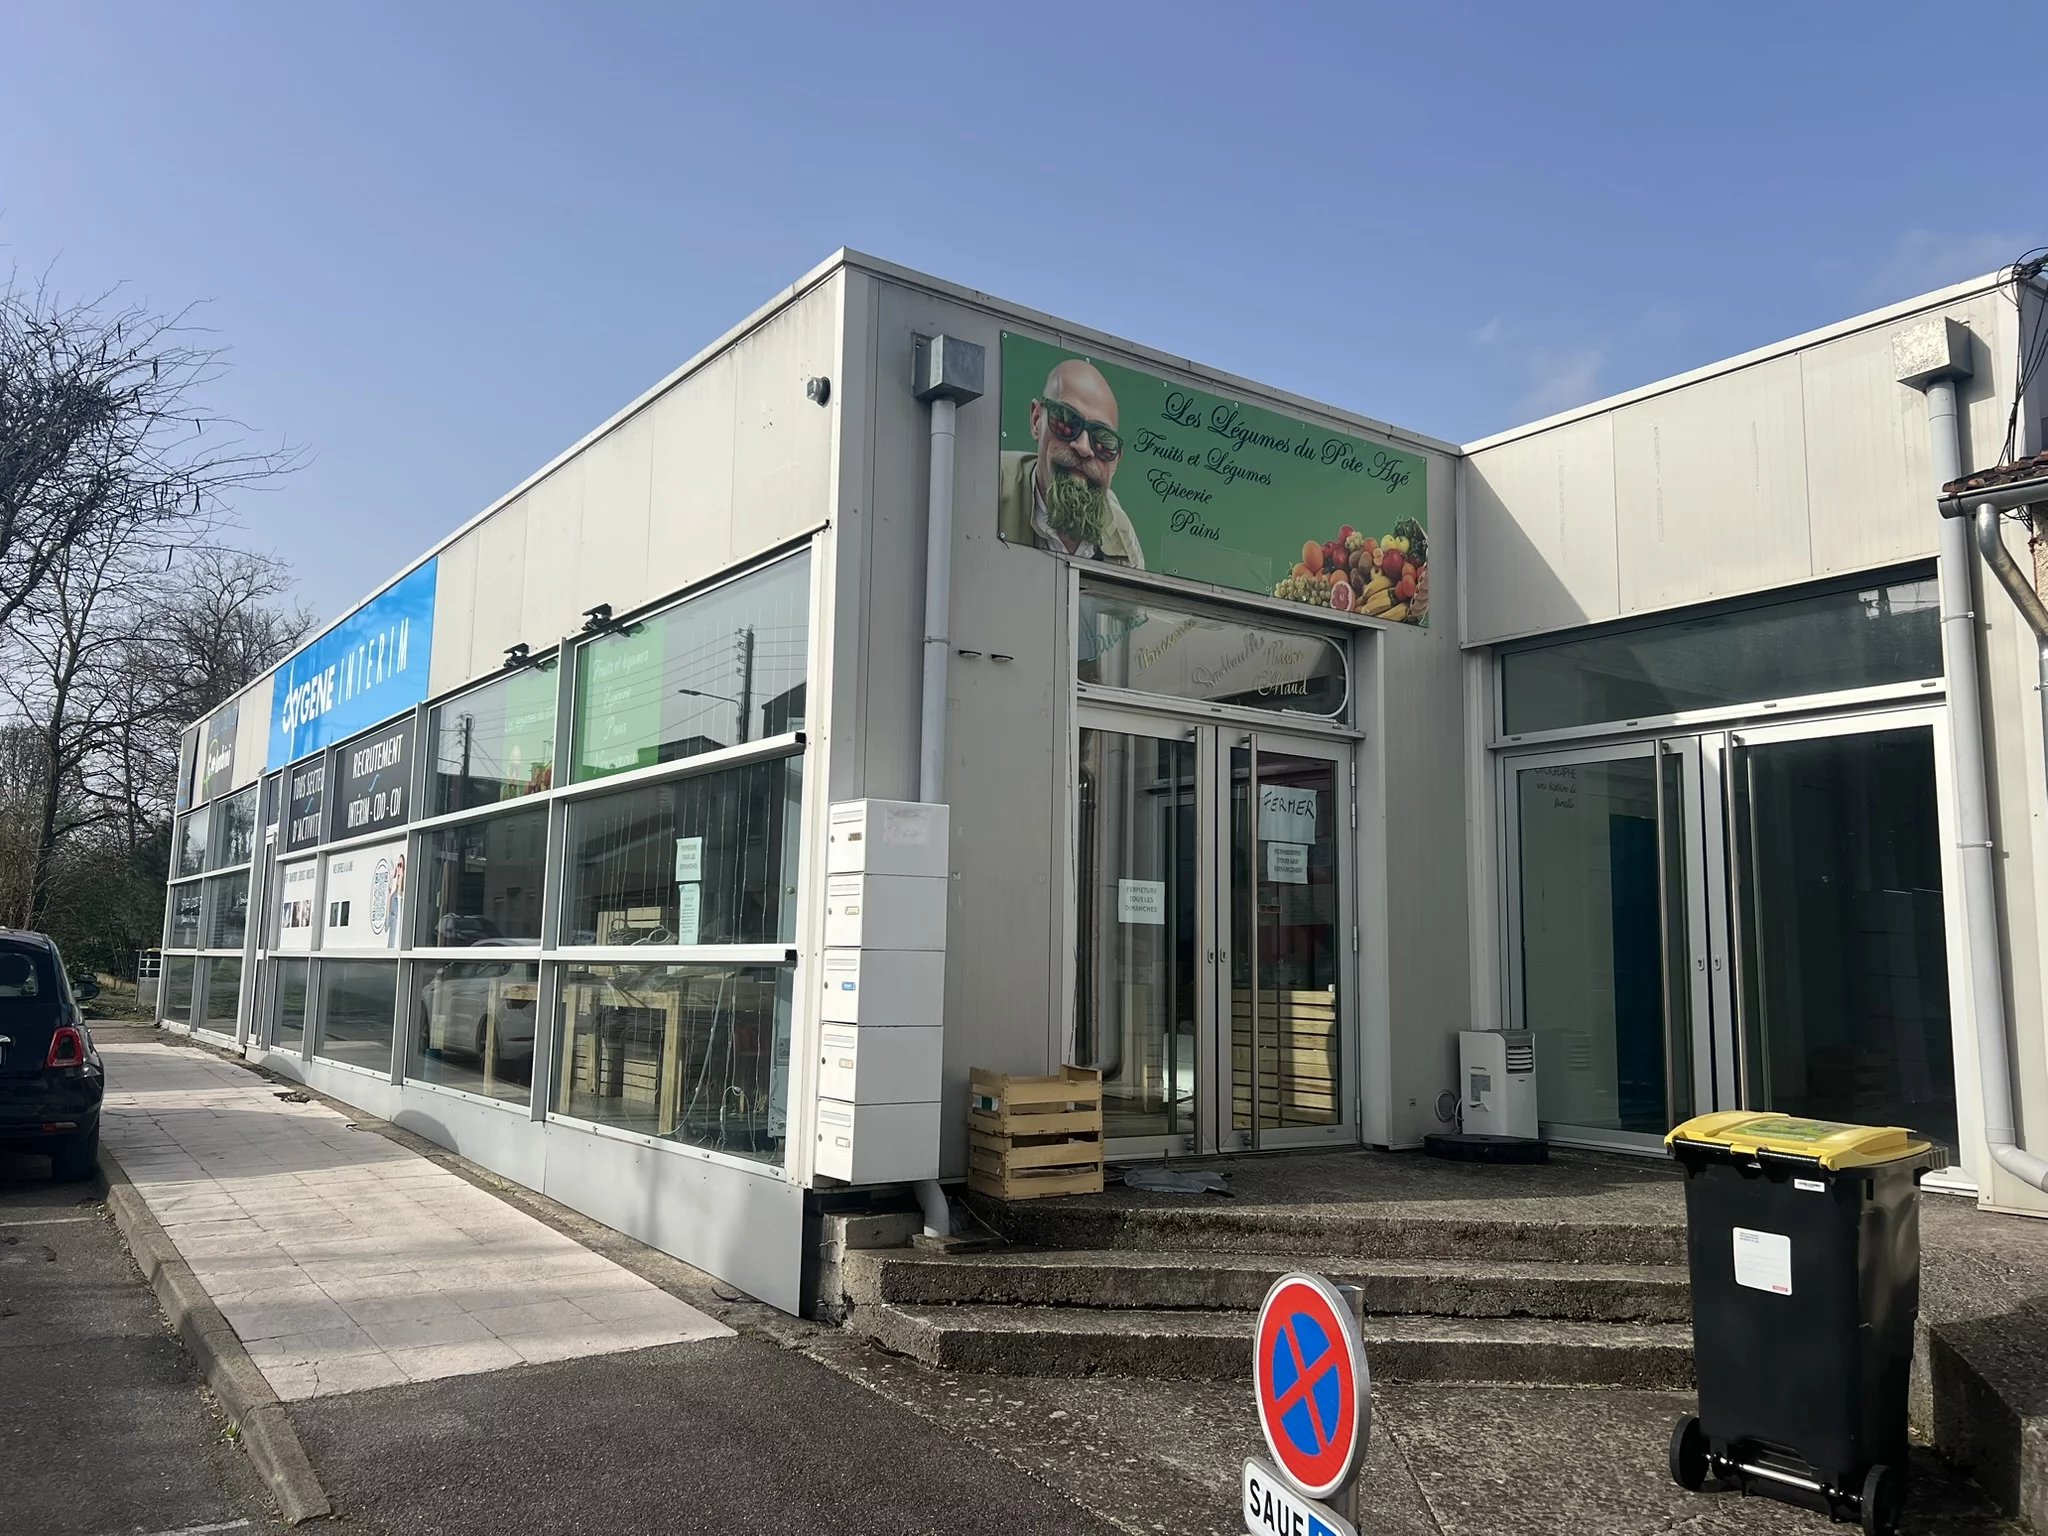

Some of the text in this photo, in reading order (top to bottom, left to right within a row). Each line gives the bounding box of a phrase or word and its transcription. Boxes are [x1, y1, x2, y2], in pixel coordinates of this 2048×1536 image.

[1134, 427, 1272, 485] Fruits et Légumes
[1161, 392, 1411, 493] Les Légumes du Pote Agé
[1147, 468, 1213, 504] Epicerie
[1171, 509, 1221, 541] Pains
[338, 617, 409, 704] INTERIM
[352, 734, 404, 779] RECRUTEMENT
[347, 793, 370, 829] INTÉRIM
[373, 791, 386, 822] CDD
[390, 786, 402, 817] CDI
[1264, 791, 1315, 820] FERMER
[1250, 1478, 1304, 1536] SAUF
